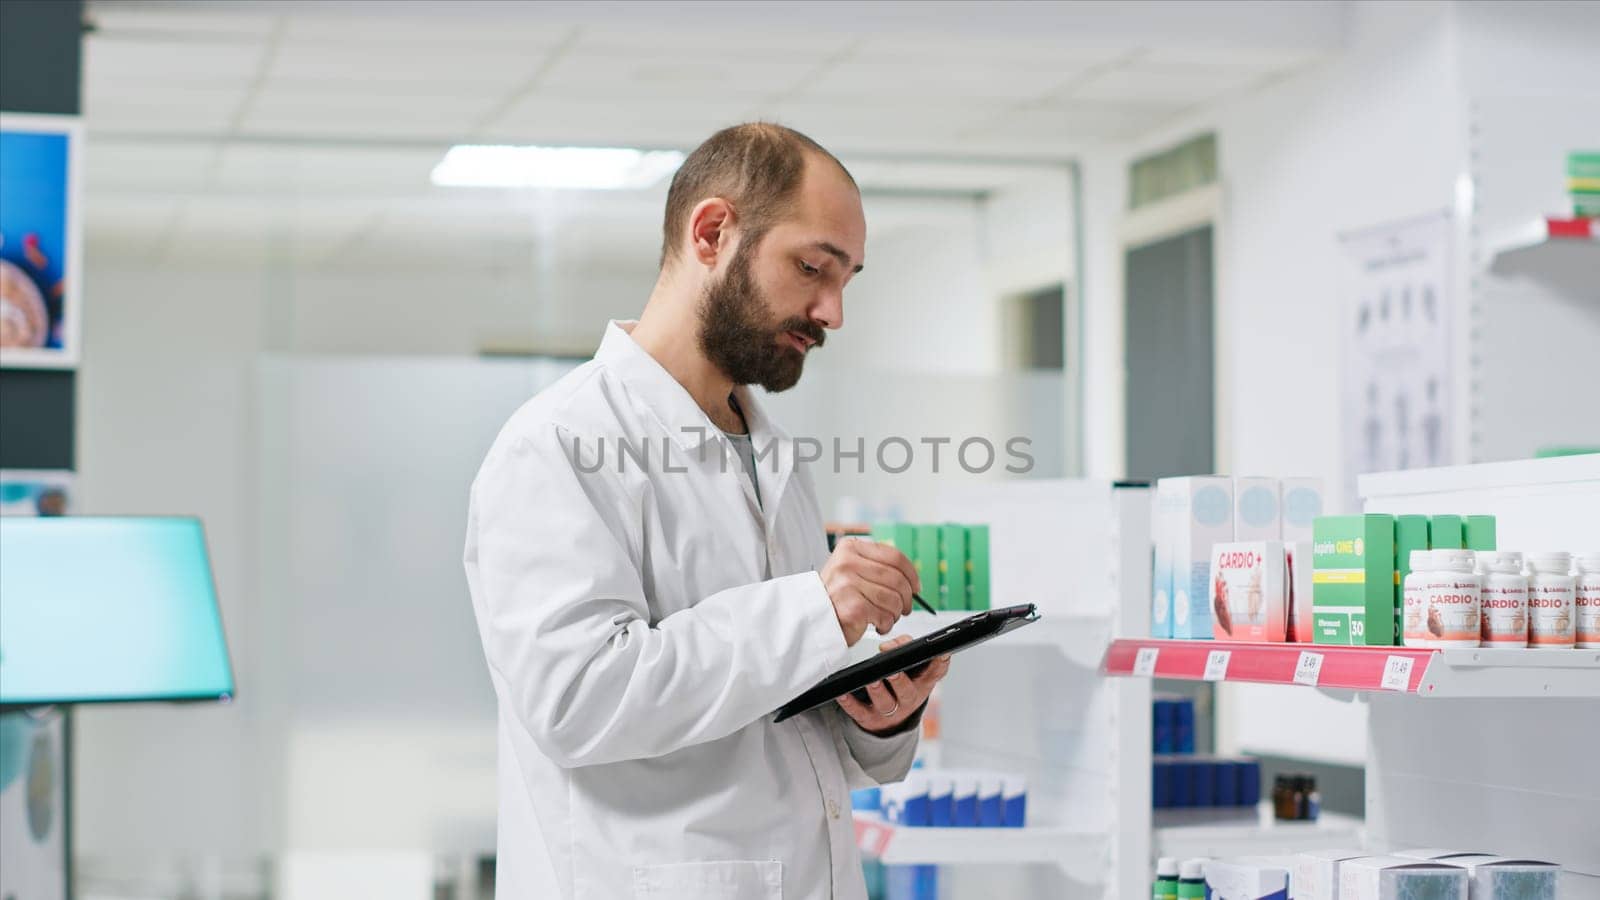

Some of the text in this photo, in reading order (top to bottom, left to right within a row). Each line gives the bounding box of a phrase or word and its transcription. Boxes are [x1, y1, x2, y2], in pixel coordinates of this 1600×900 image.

[1219, 551, 1253, 569] CARDIO
[1430, 594, 1472, 604] CARDIO
[1528, 598, 1562, 609] ARDIO
[1575, 597, 1600, 607] RDIO
[1351, 620, 1364, 636] 30
